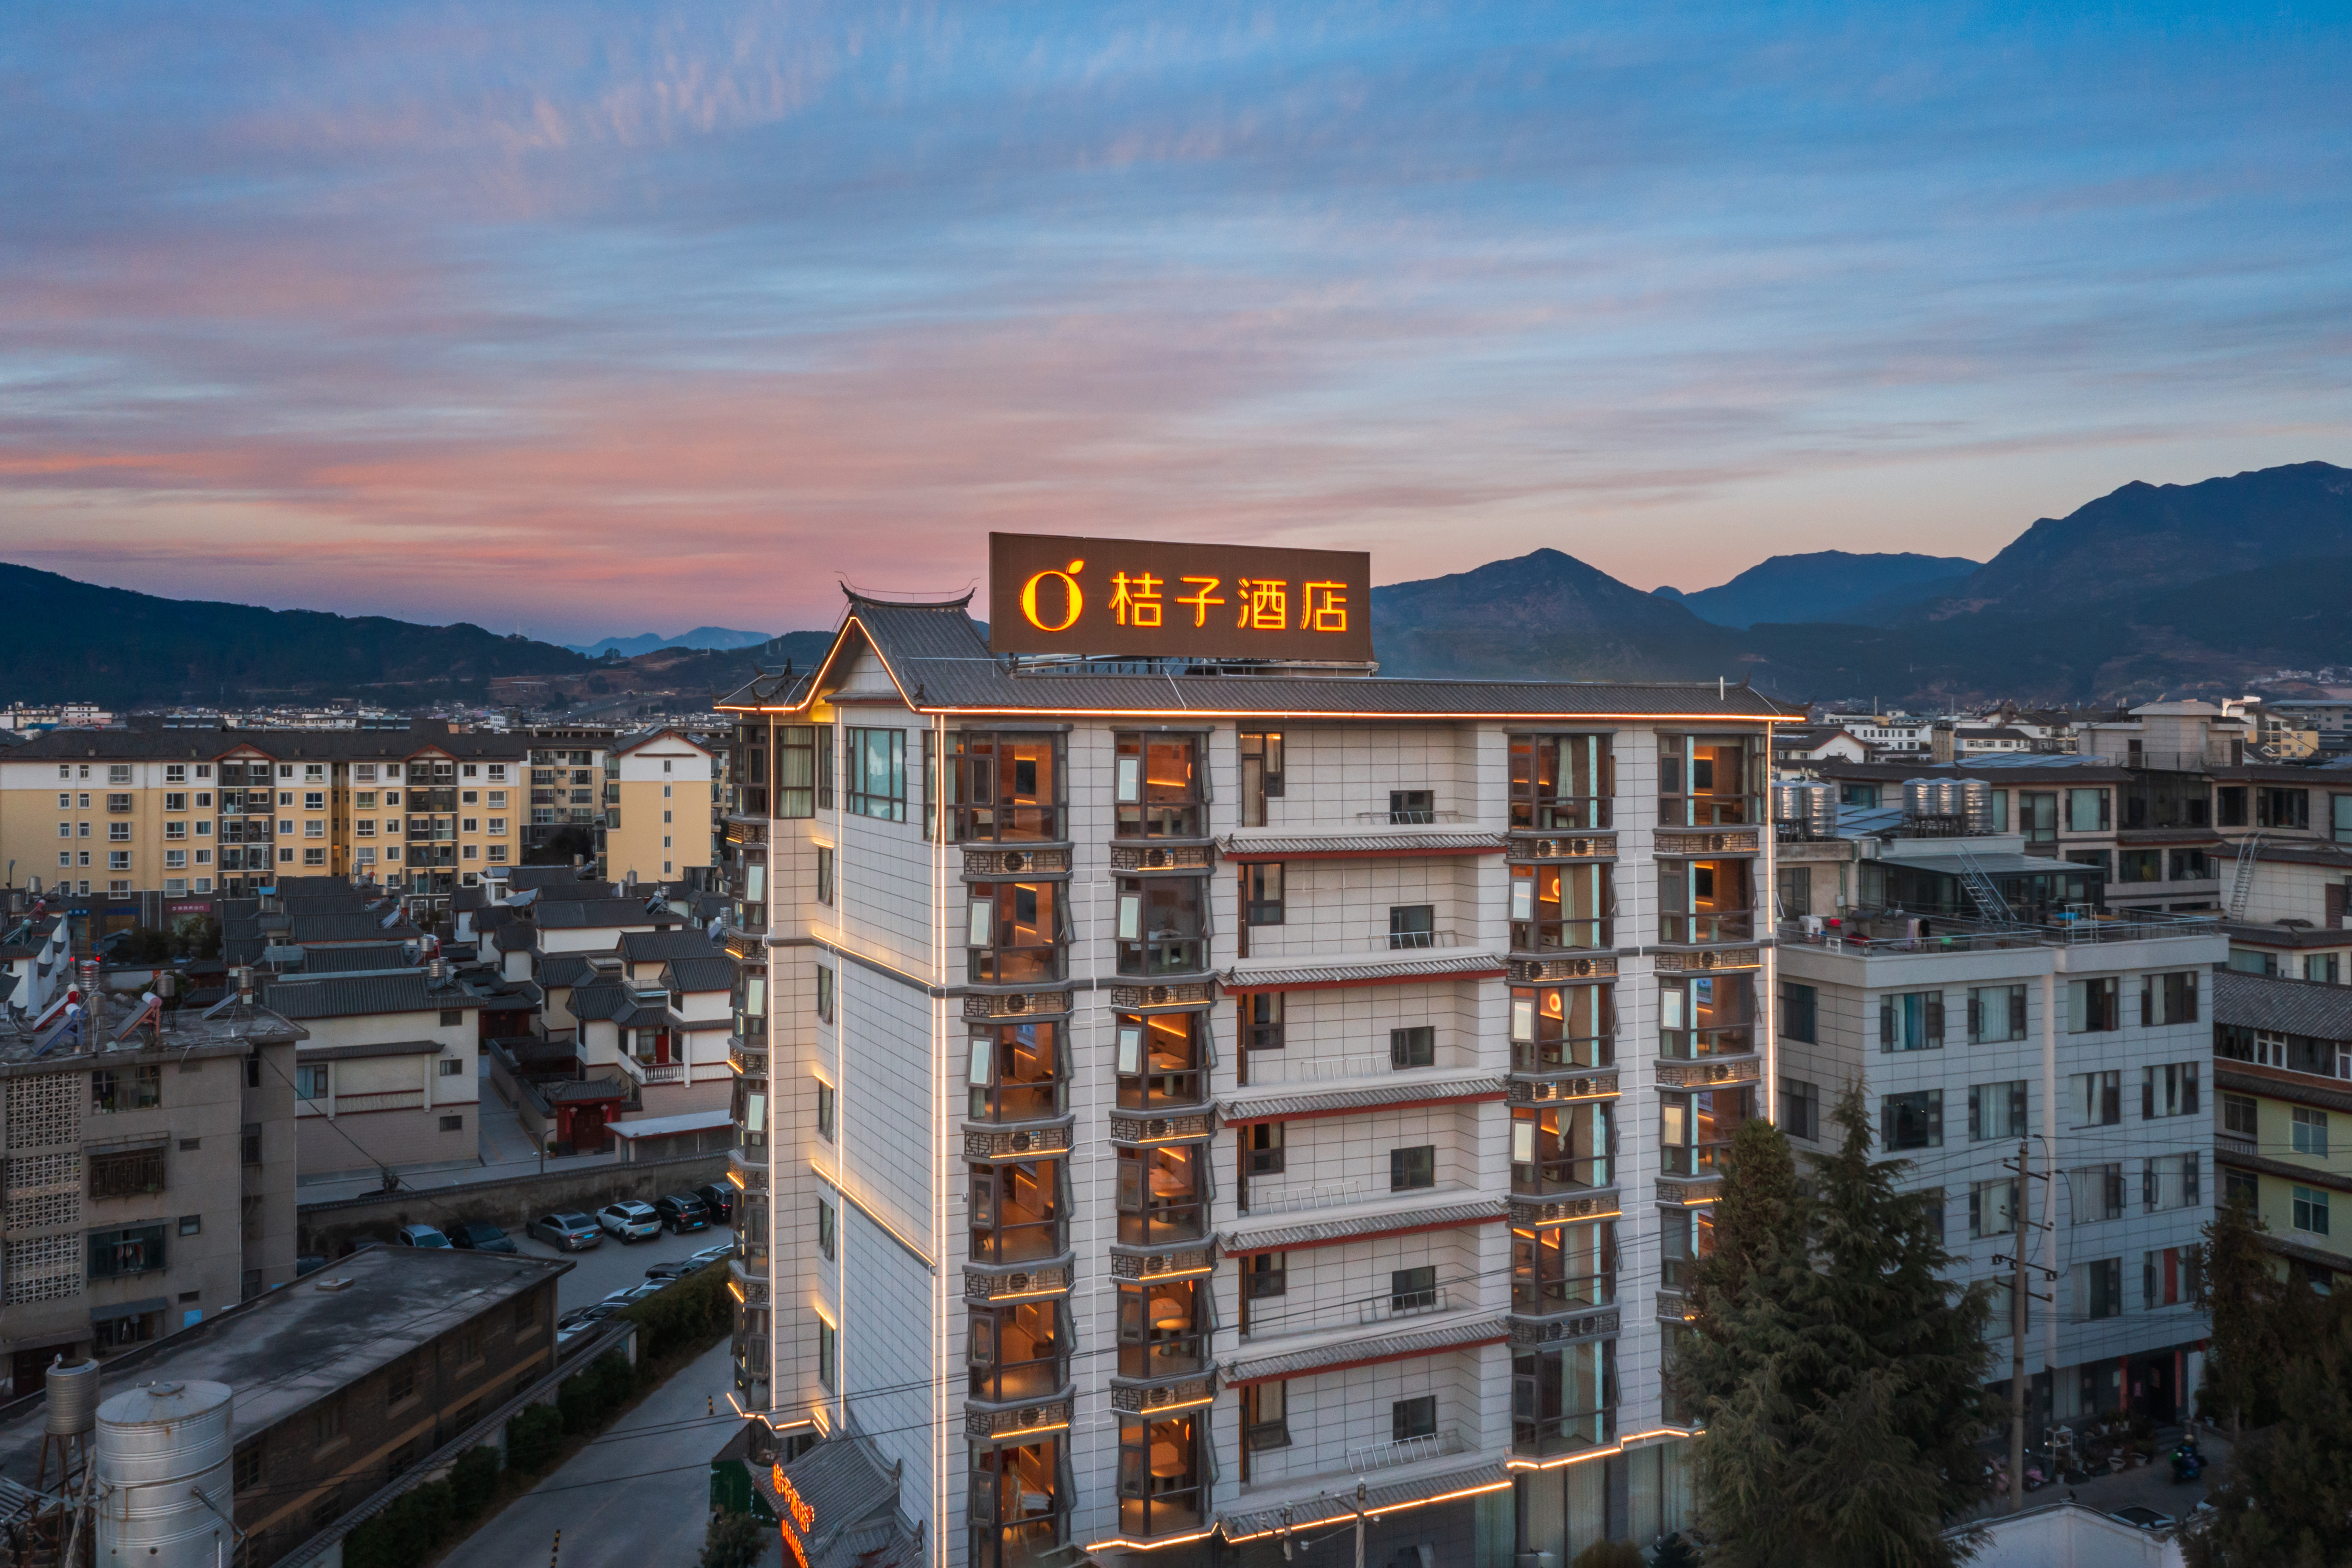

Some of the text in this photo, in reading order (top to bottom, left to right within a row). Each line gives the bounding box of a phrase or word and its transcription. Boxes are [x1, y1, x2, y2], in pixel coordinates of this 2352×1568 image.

[1108, 570, 1348, 632] 桔子酒店
[773, 1464, 809, 1533] 桔子酒店
